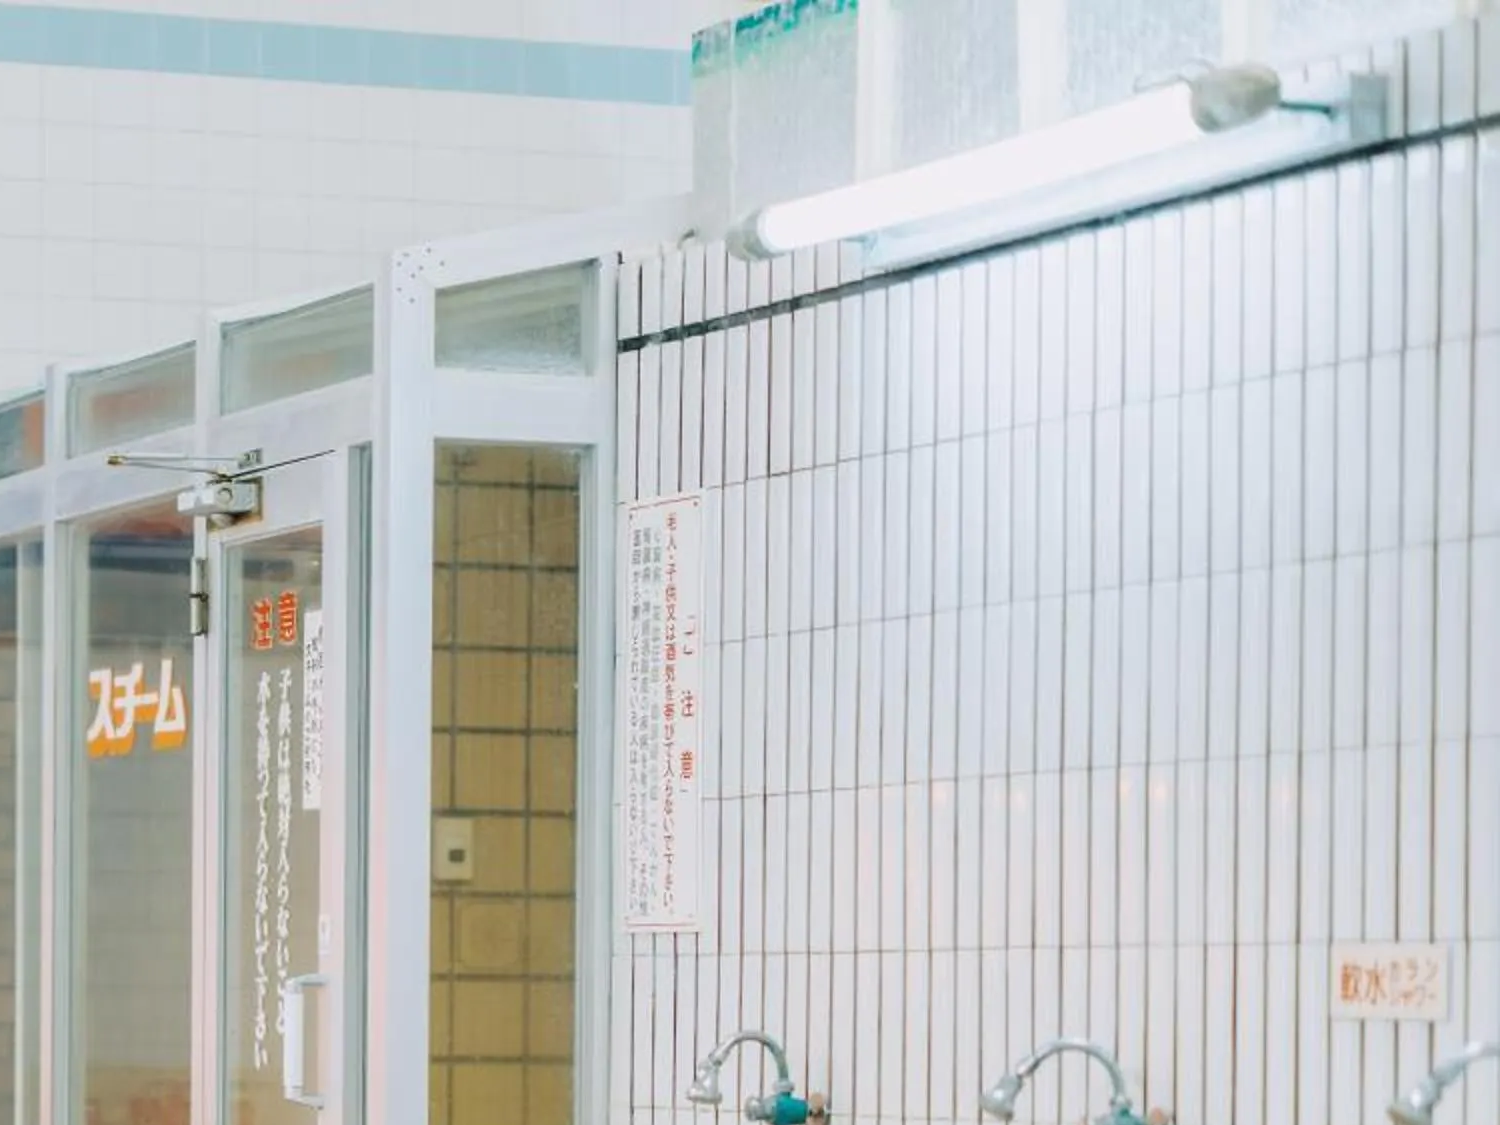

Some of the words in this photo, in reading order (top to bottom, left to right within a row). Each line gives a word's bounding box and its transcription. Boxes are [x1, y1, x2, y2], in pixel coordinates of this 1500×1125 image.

[249, 590, 298, 651] 注意
[87, 658, 187, 755] スチーム
